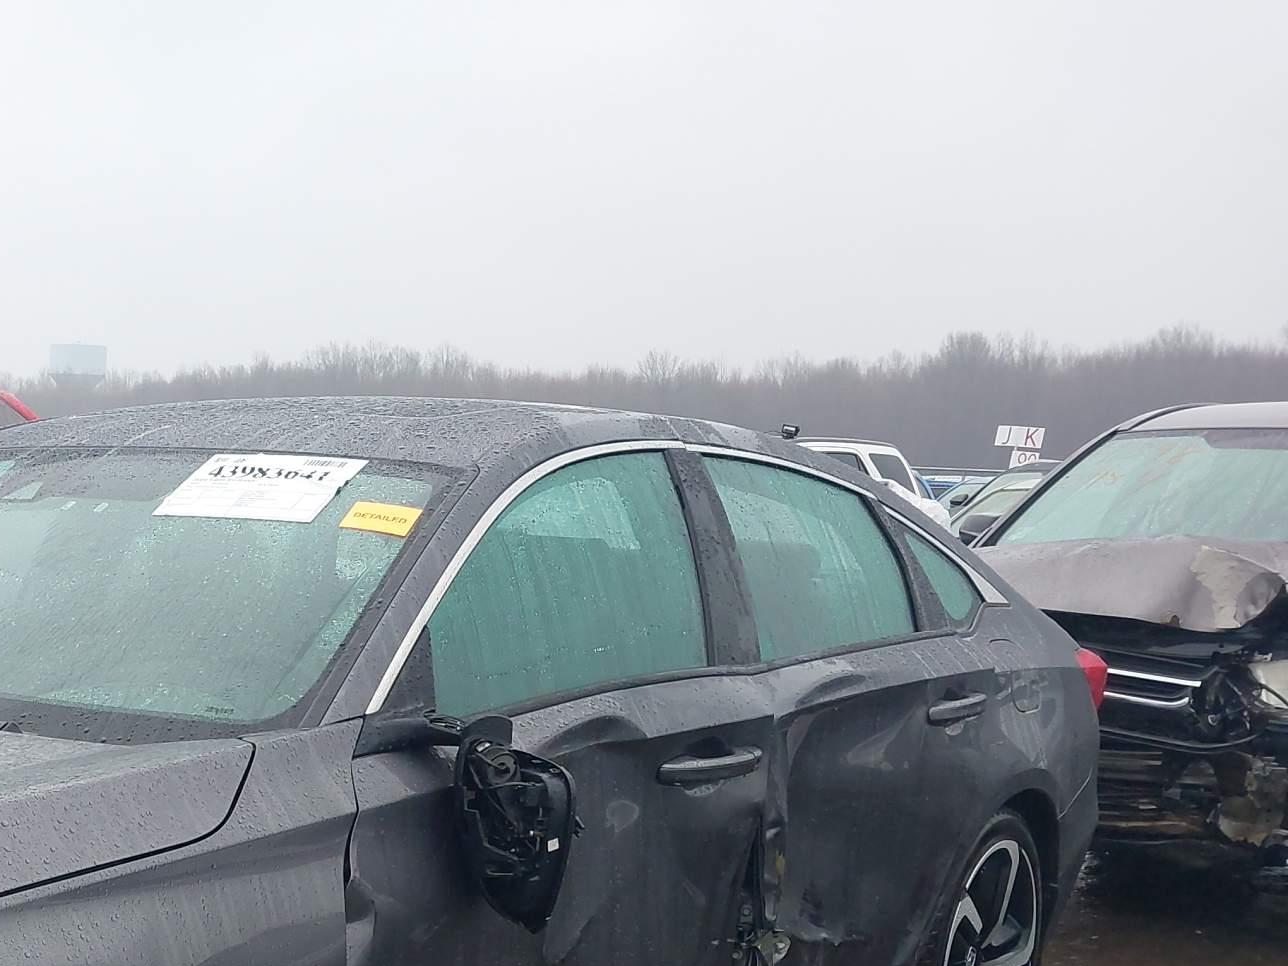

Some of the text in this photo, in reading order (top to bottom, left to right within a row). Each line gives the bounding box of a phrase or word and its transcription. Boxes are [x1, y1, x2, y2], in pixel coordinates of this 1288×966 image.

[1002, 427, 1039, 447] J K
[353, 511, 408, 524] DETAILED
